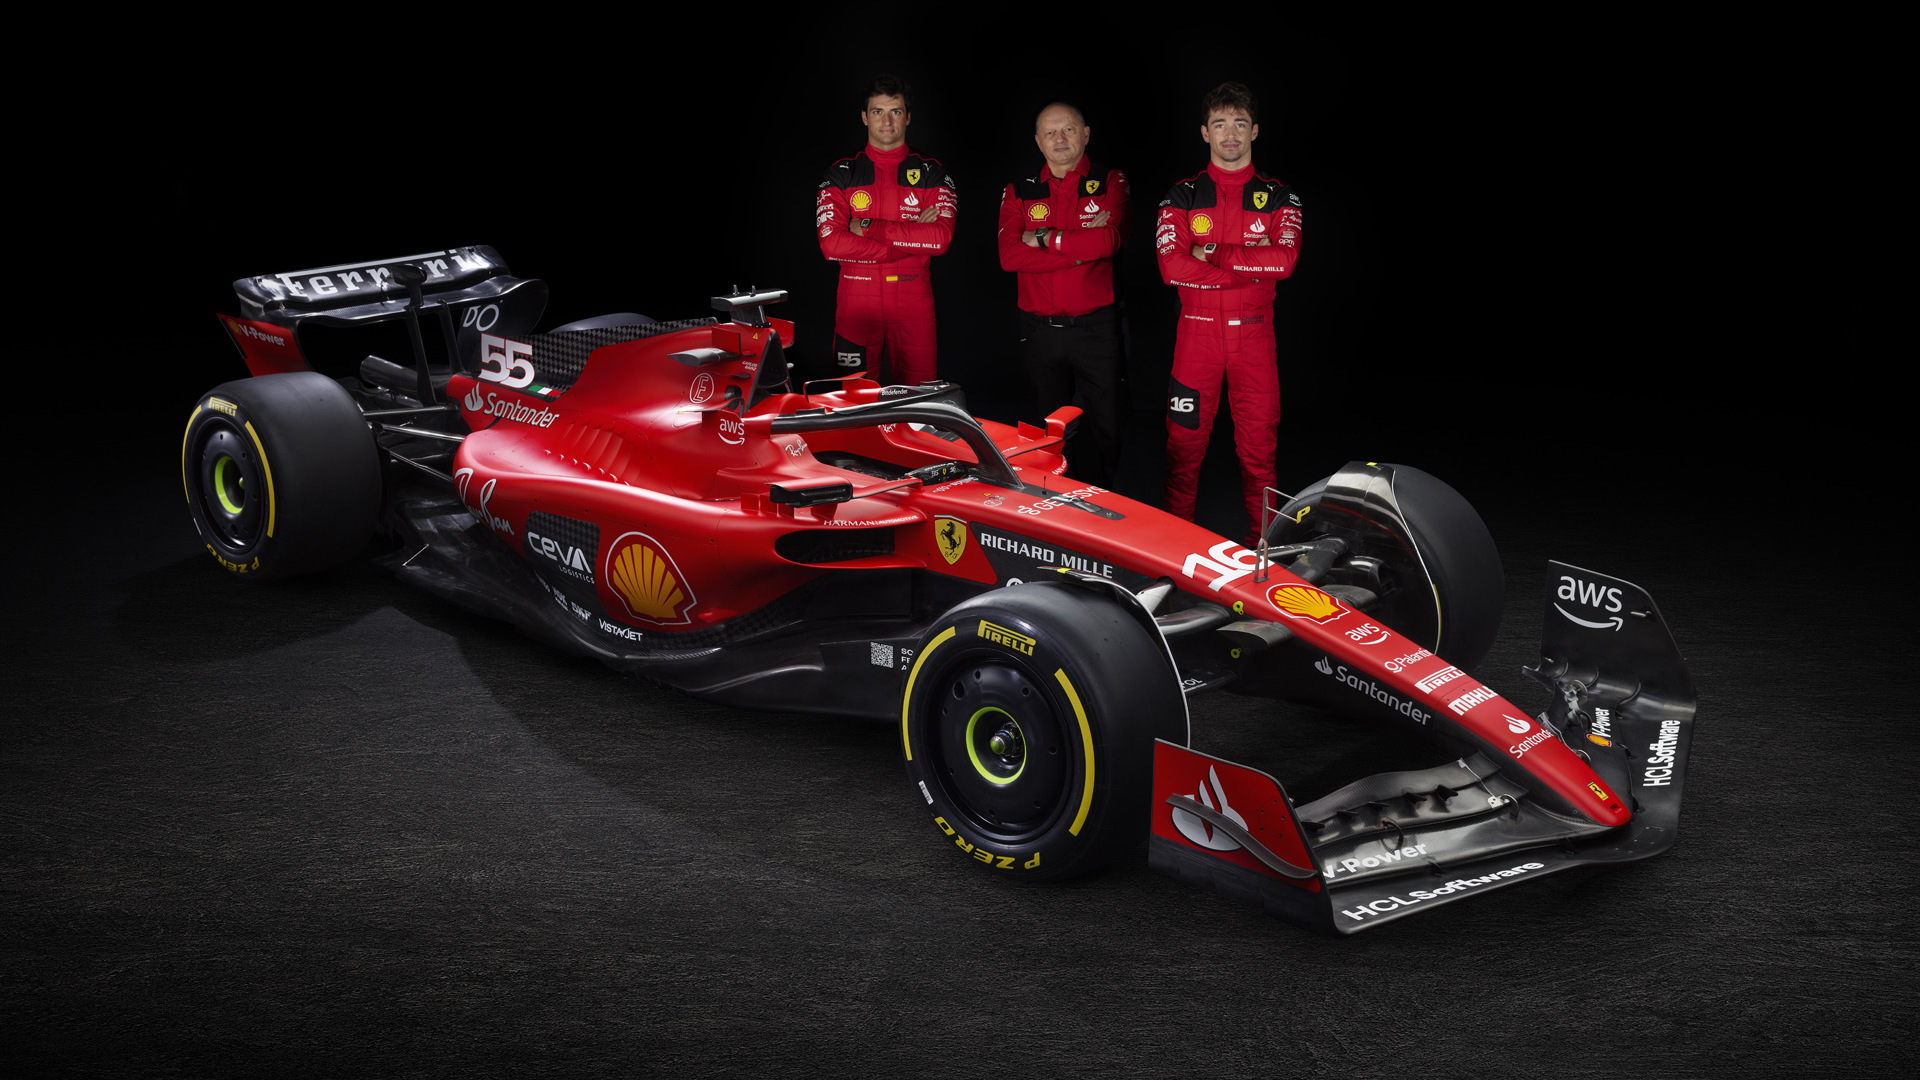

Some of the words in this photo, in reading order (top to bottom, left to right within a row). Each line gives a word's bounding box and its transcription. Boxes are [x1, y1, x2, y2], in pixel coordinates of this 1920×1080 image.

[275, 249, 478, 298] Ferrri
[1170, 280, 1199, 289] RICHARD
[238, 324, 285, 346] V-Power
[478, 333, 535, 389] 55
[838, 352, 861, 367] 55
[208, 396, 238, 417] PIRELLI
[484, 392, 560, 428] Santander
[1170, 396, 1194, 412] 16
[720, 418, 745, 436] aws
[1033, 486, 1110, 510] GEESYS
[879, 515, 918, 524] AUTOMOTIVE
[206, 544, 248, 573] ZERO
[981, 532, 1054, 563] RICHARD
[1061, 553, 1113, 579] MILLE
[1182, 540, 1275, 592] 16
[558, 565, 594, 584] LOGISTICS
[1557, 576, 1622, 612] aws
[977, 620, 1036, 656] PIRELLI
[1345, 623, 1380, 640] aws
[1414, 666, 1467, 694] PIRELL
[1336, 666, 1432, 726] Santander
[1592, 708, 1611, 738] V-Power
[1510, 728, 1554, 758] Santand
[1643, 720, 1680, 786] HCLSoftware
[934, 816, 1015, 869] ZERO
[1024, 852, 1040, 869] P
[1322, 843, 1427, 878] V-Power
[1341, 862, 1544, 920] HCLSoftware
